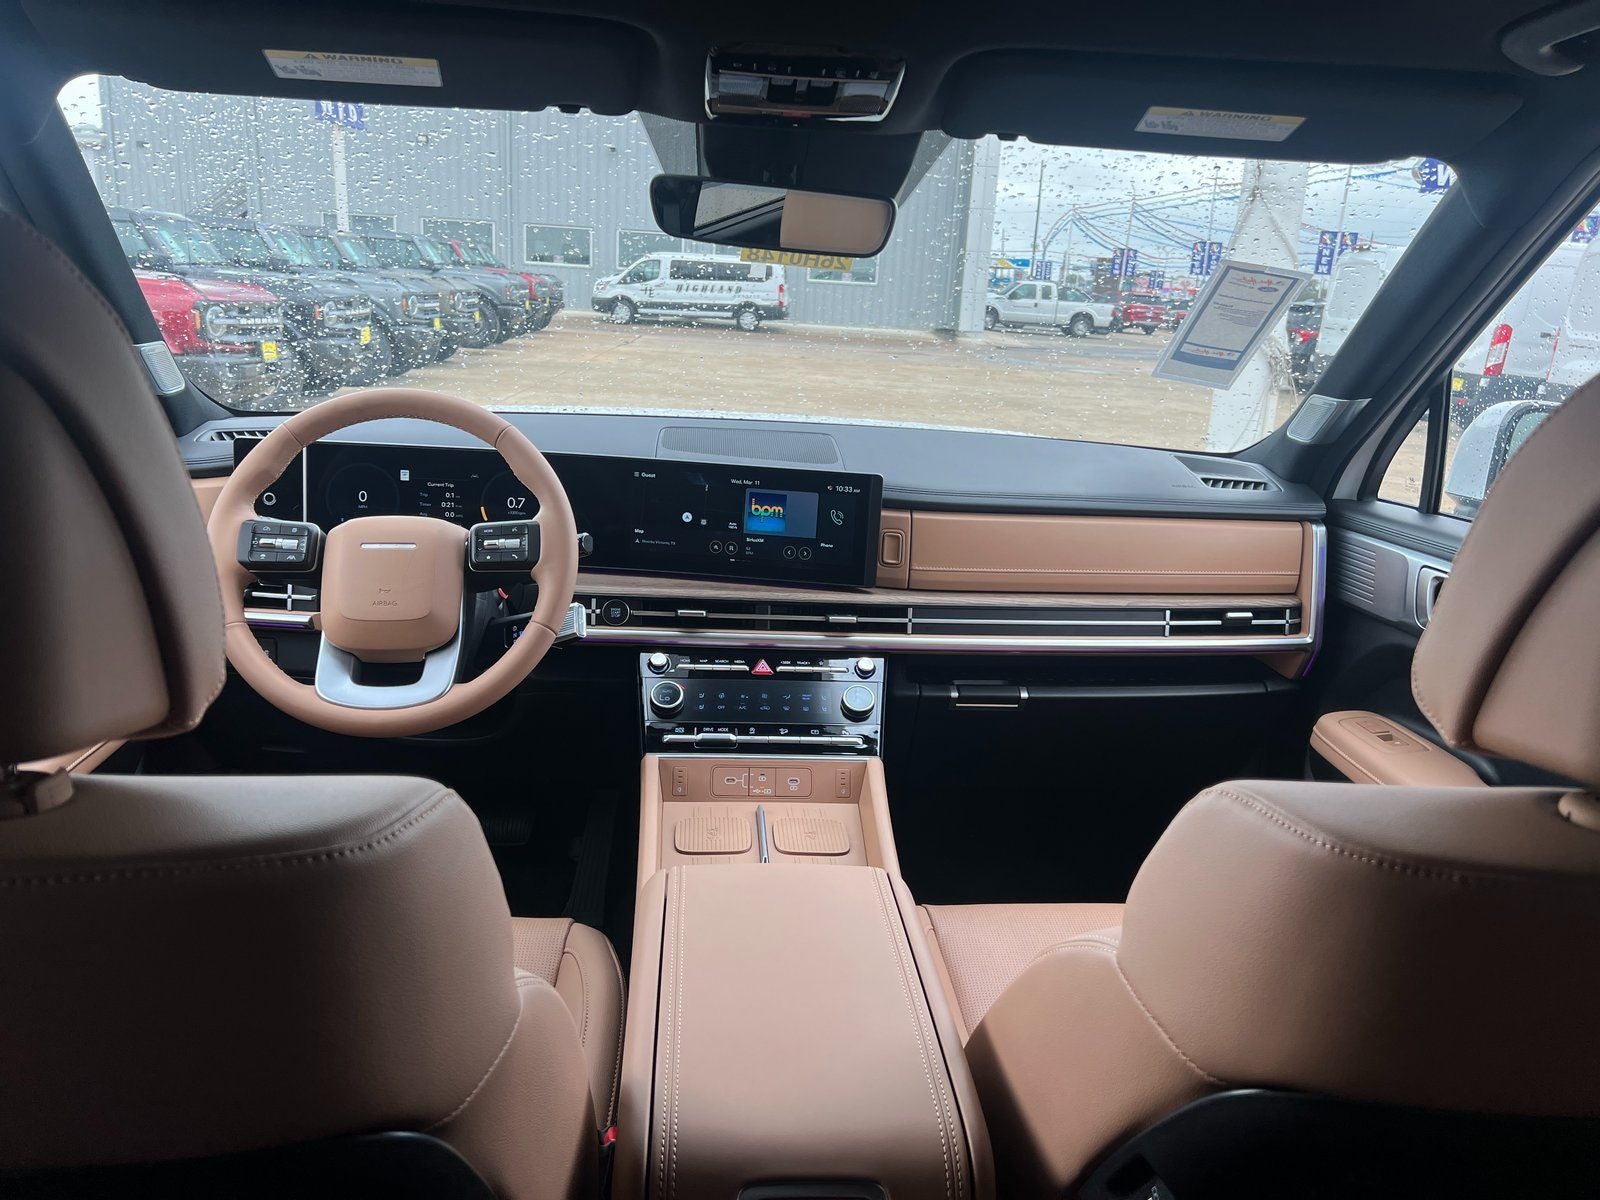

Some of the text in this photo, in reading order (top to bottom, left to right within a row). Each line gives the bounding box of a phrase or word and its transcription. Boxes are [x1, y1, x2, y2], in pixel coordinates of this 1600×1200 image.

[322, 53, 403, 65] WARNING
[1199, 111, 1272, 122] WARNING
[676, 284, 742, 294] HIGHLAND
[836, 485, 853, 493] 10:33
[358, 490, 368, 502] 0
[507, 497, 526, 509] 0.7
[751, 498, 784, 522] bpm
